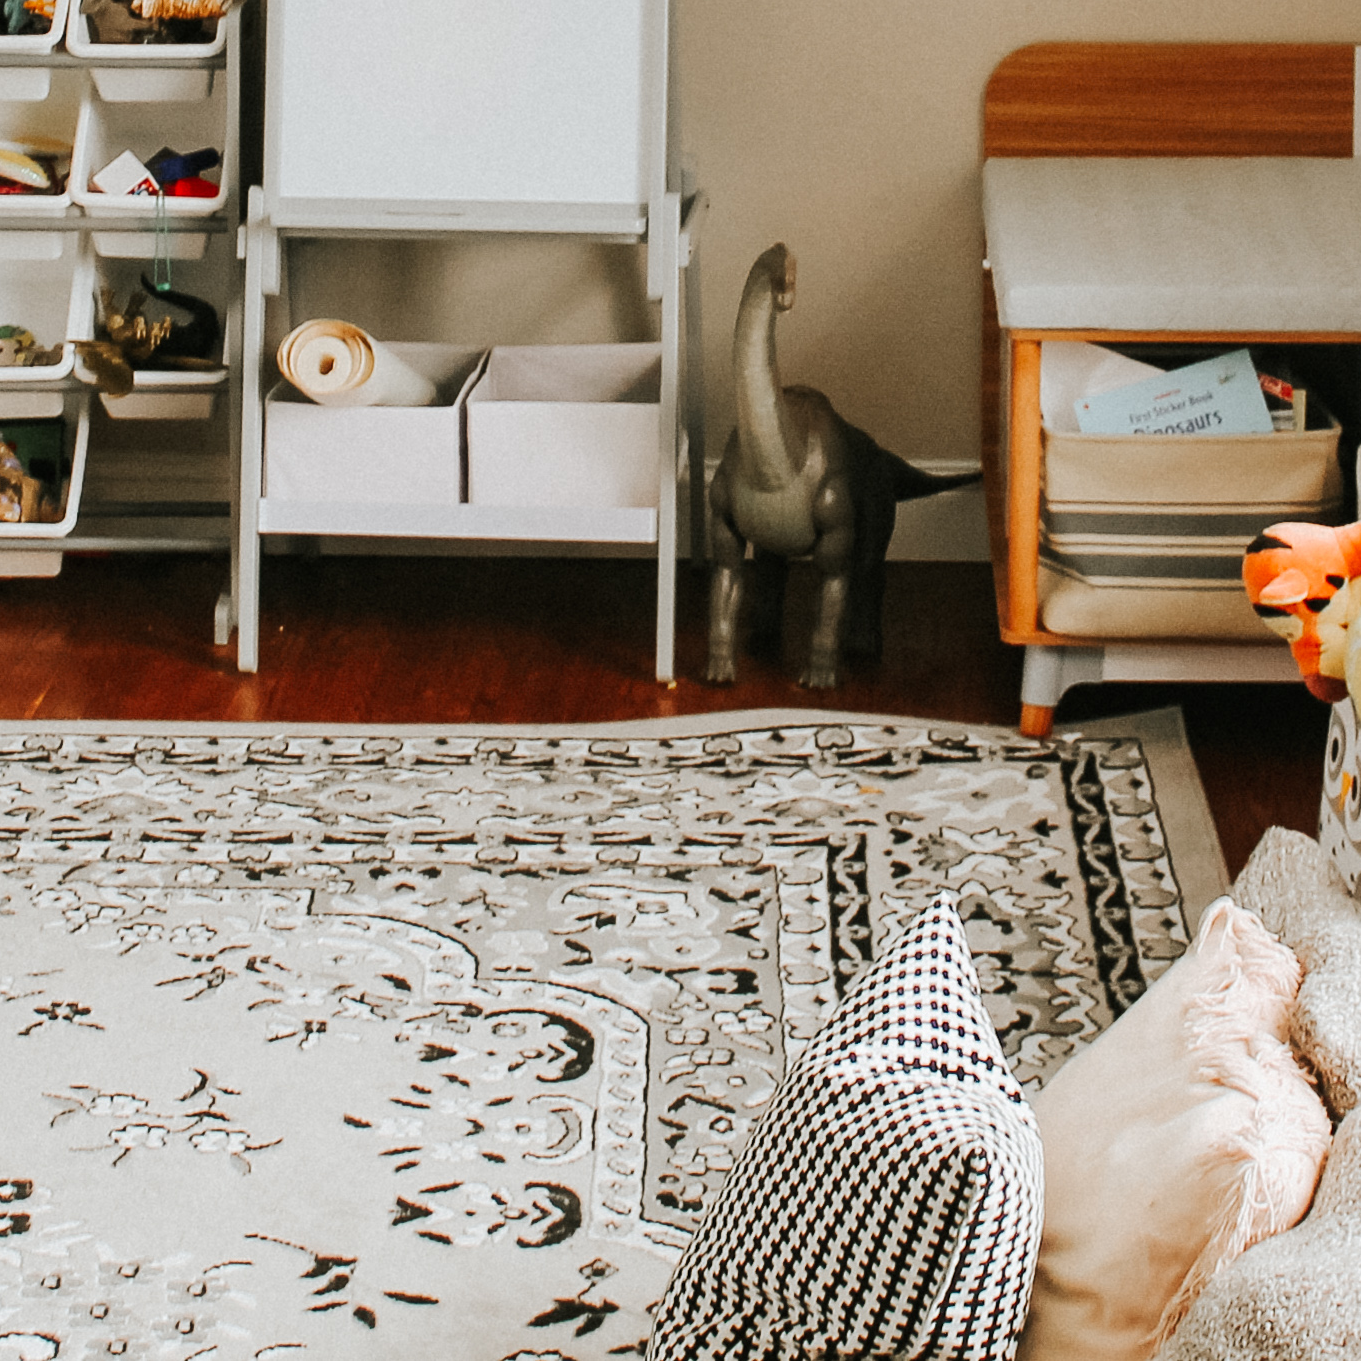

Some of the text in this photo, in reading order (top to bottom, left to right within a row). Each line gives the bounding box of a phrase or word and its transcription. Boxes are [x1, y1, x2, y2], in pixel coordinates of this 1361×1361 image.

[1129, 409, 1151, 425] First
[1153, 400, 1186, 416] Sticker
[1188, 391, 1214, 406] Book
[1134, 410, 1223, 435] nosaurs
